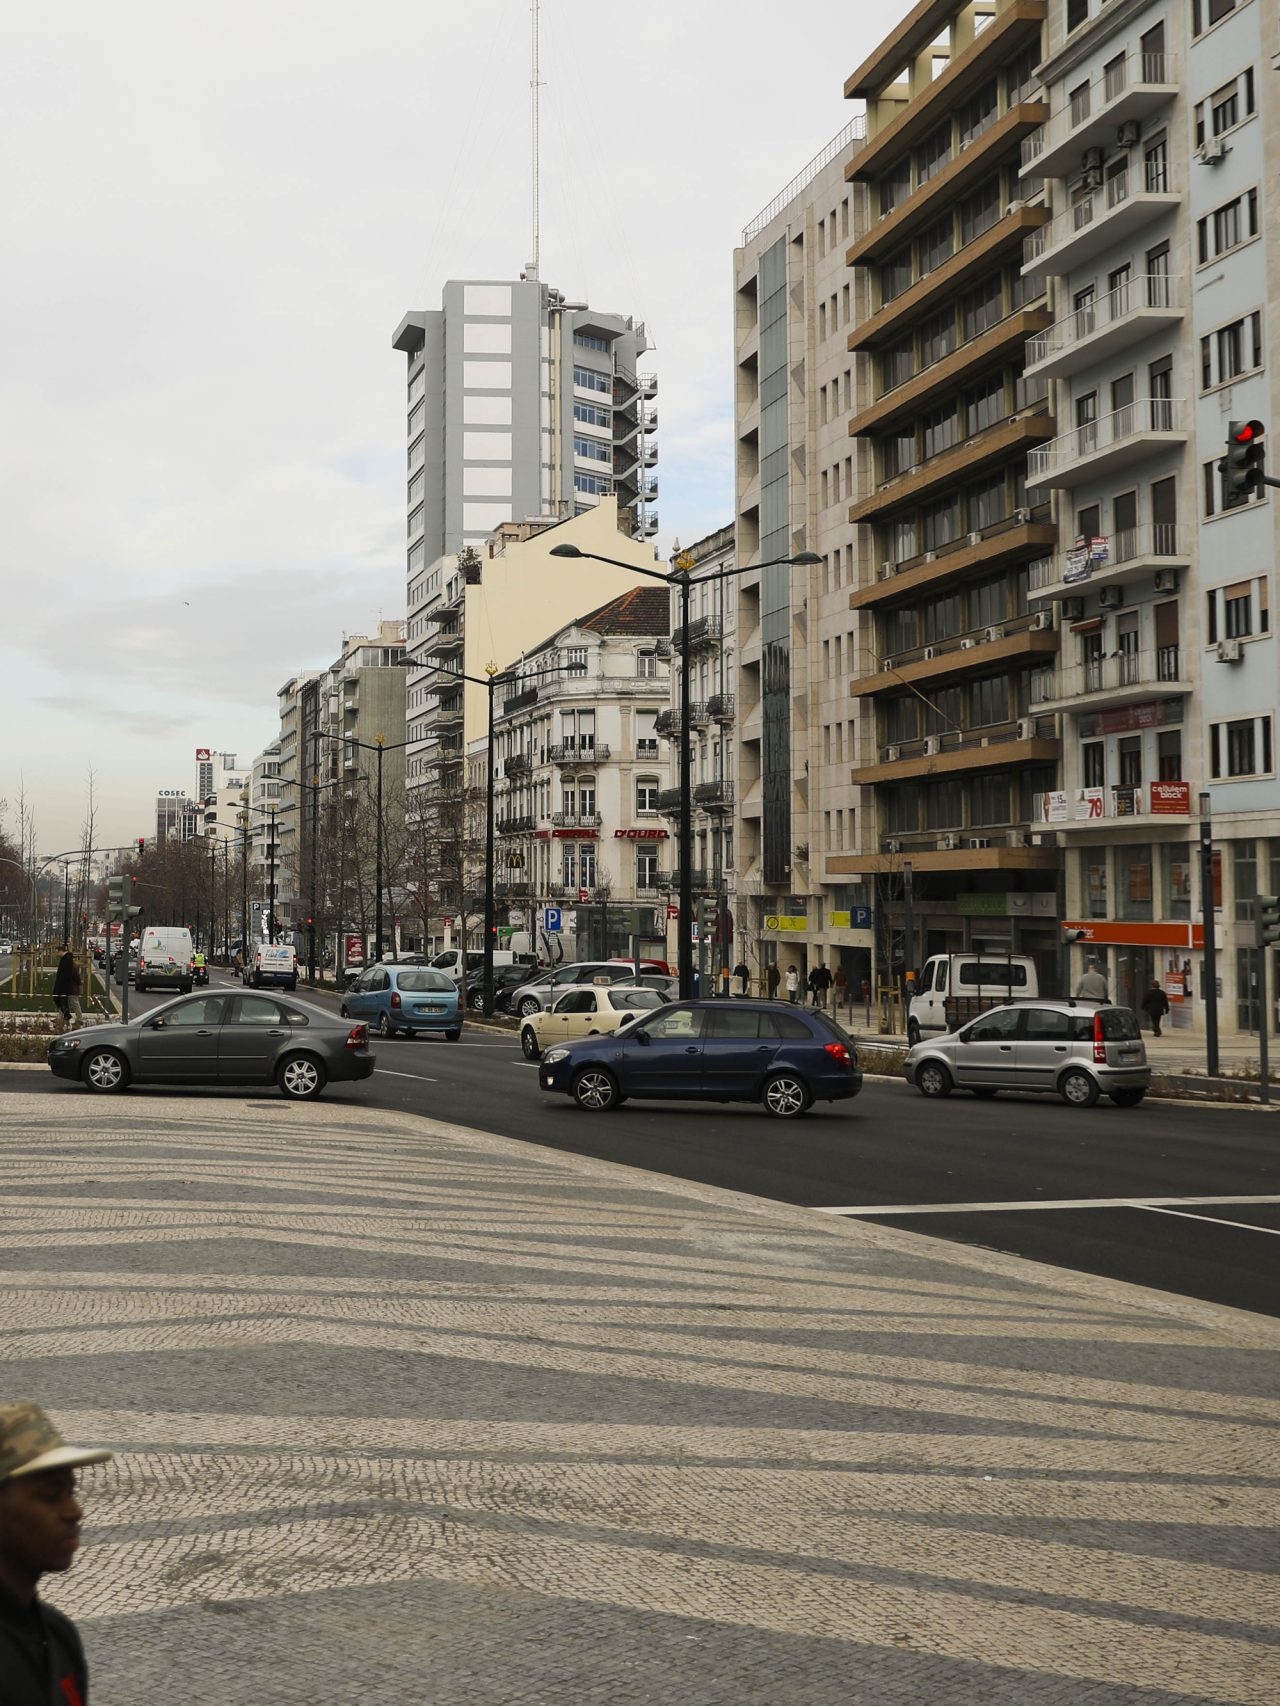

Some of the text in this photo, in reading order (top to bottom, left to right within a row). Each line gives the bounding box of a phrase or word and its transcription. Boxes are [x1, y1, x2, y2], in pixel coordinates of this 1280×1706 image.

[253, 903, 260, 911] P
[548, 910, 558, 929] P
[857, 910, 866, 923] P
